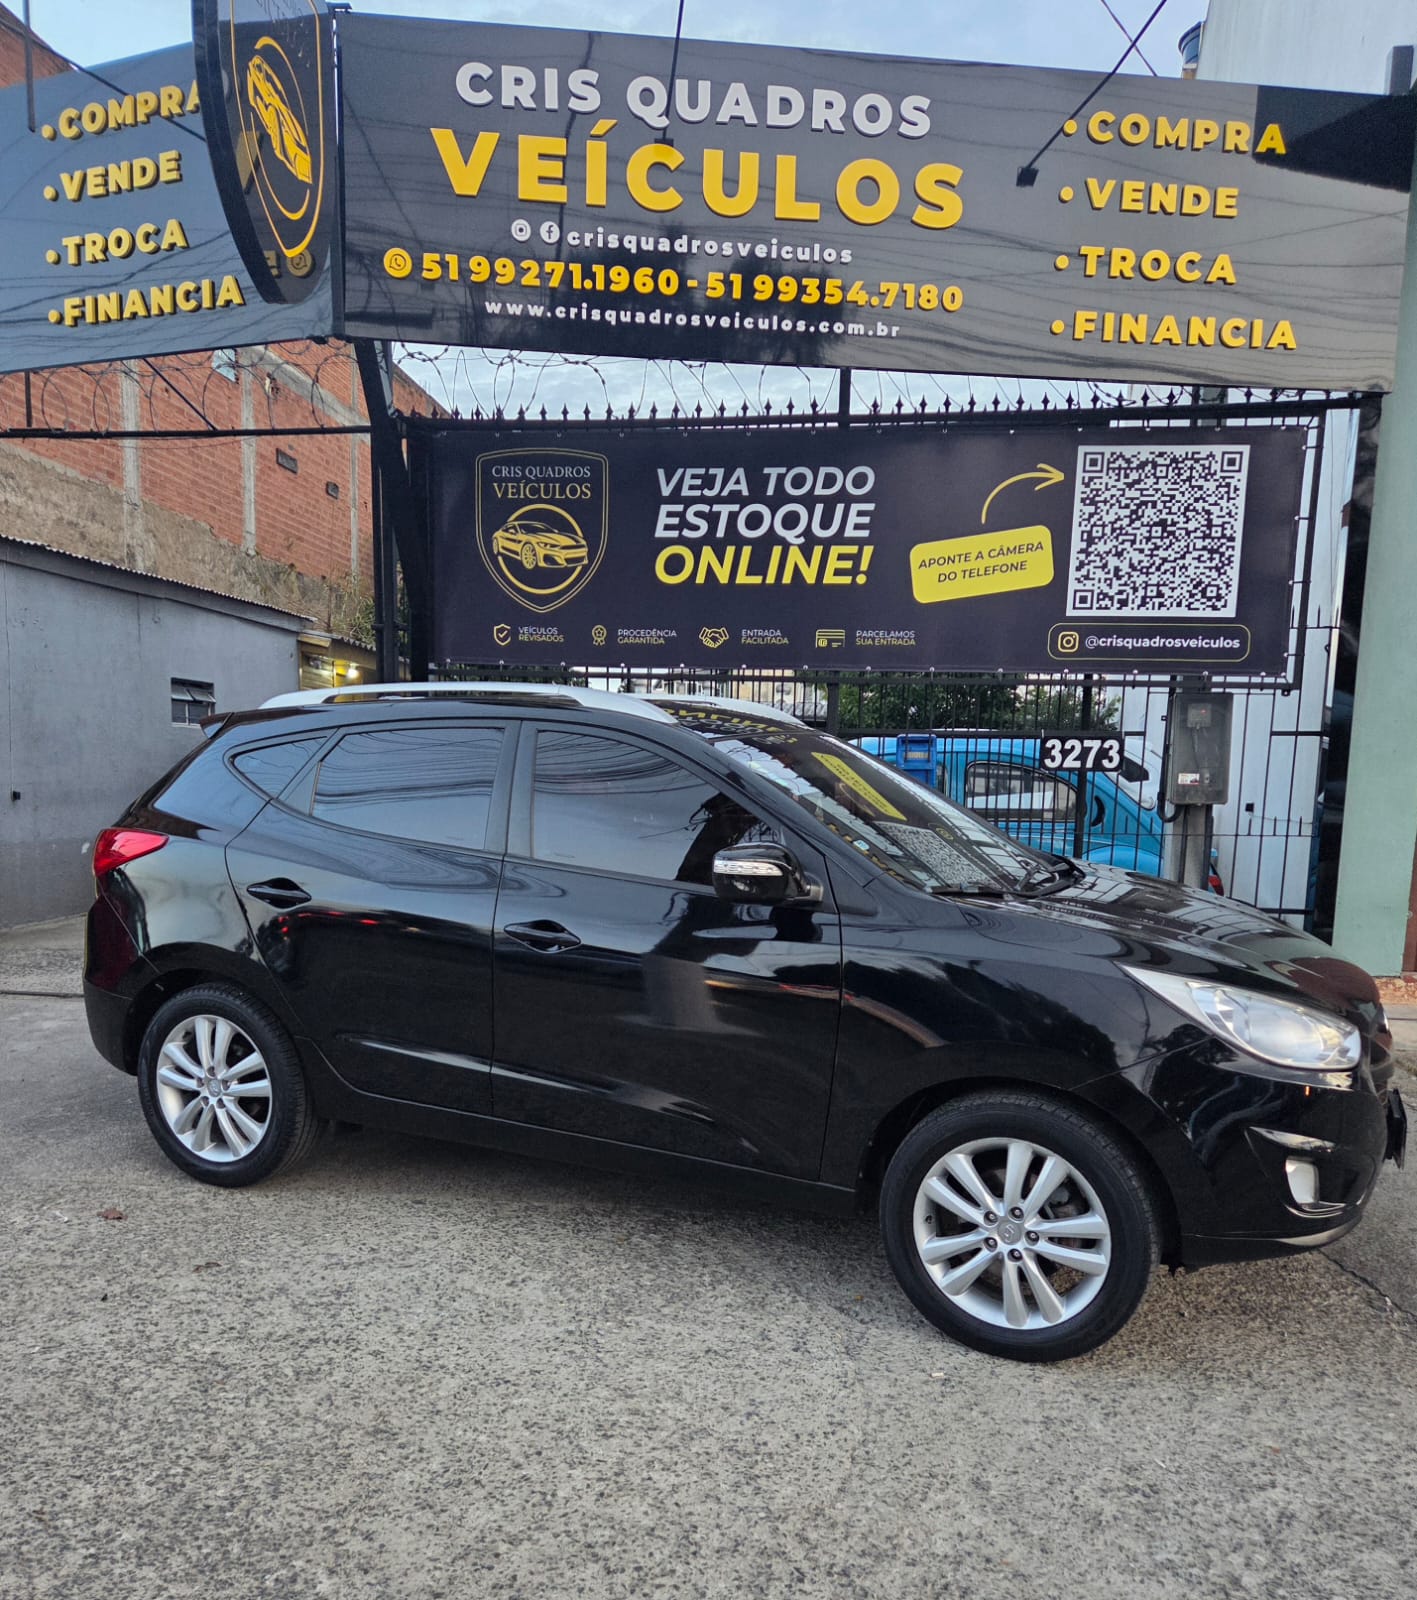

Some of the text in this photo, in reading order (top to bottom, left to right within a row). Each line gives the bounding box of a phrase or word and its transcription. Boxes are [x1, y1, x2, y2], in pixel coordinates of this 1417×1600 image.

[455, 62, 931, 138] CRIS QUADROS
[1087, 111, 1286, 155] COMPRA
[60, 150, 182, 201] VENDE
[430, 119, 965, 229] VEÍCULOS
[1086, 178, 1239, 218] VENDE
[62, 218, 188, 266] TROCA
[567, 228, 852, 264] crisquadrosveiculos
[1080, 246, 1236, 284] TROCA
[422, 252, 459, 281] 51
[468, 255, 680, 296] 99271.1960
[705, 271, 743, 300] 51
[753, 274, 964, 312] 99354.7180
[63, 275, 245, 327] FINANCIA
[485, 301, 900, 337] www.crisquadrosveiculos.com.br
[1073, 311, 1296, 350] FINANCIA
[492, 465, 591, 480] CRIS QUADROS
[656, 466, 875, 496] VEJA TODO
[493, 479, 592, 499] VEÍCULOS
[654, 503, 876, 544] ESTOQUE
[655, 545, 875, 585] ONLINE!
[918, 541, 1044, 570] APONTE A CÂMERA
[937, 560, 1028, 583] DO TELEFONE
[518, 625, 558, 635] VEÍCULOS
[518, 634, 564, 643] REVISADOS
[617, 627, 677, 637] PROCEDÊNCIA
[617, 637, 665, 645] GARANTIDA
[741, 629, 782, 637] ENTRADA
[741, 637, 789, 645] FACILITADA
[855, 638, 916, 646] SUA ENTRADA
[856, 630, 916, 639] PARCELAMOS
[1085, 635, 1241, 650] @crisquadrosveiculos
[1043, 738, 1120, 769] 3273
